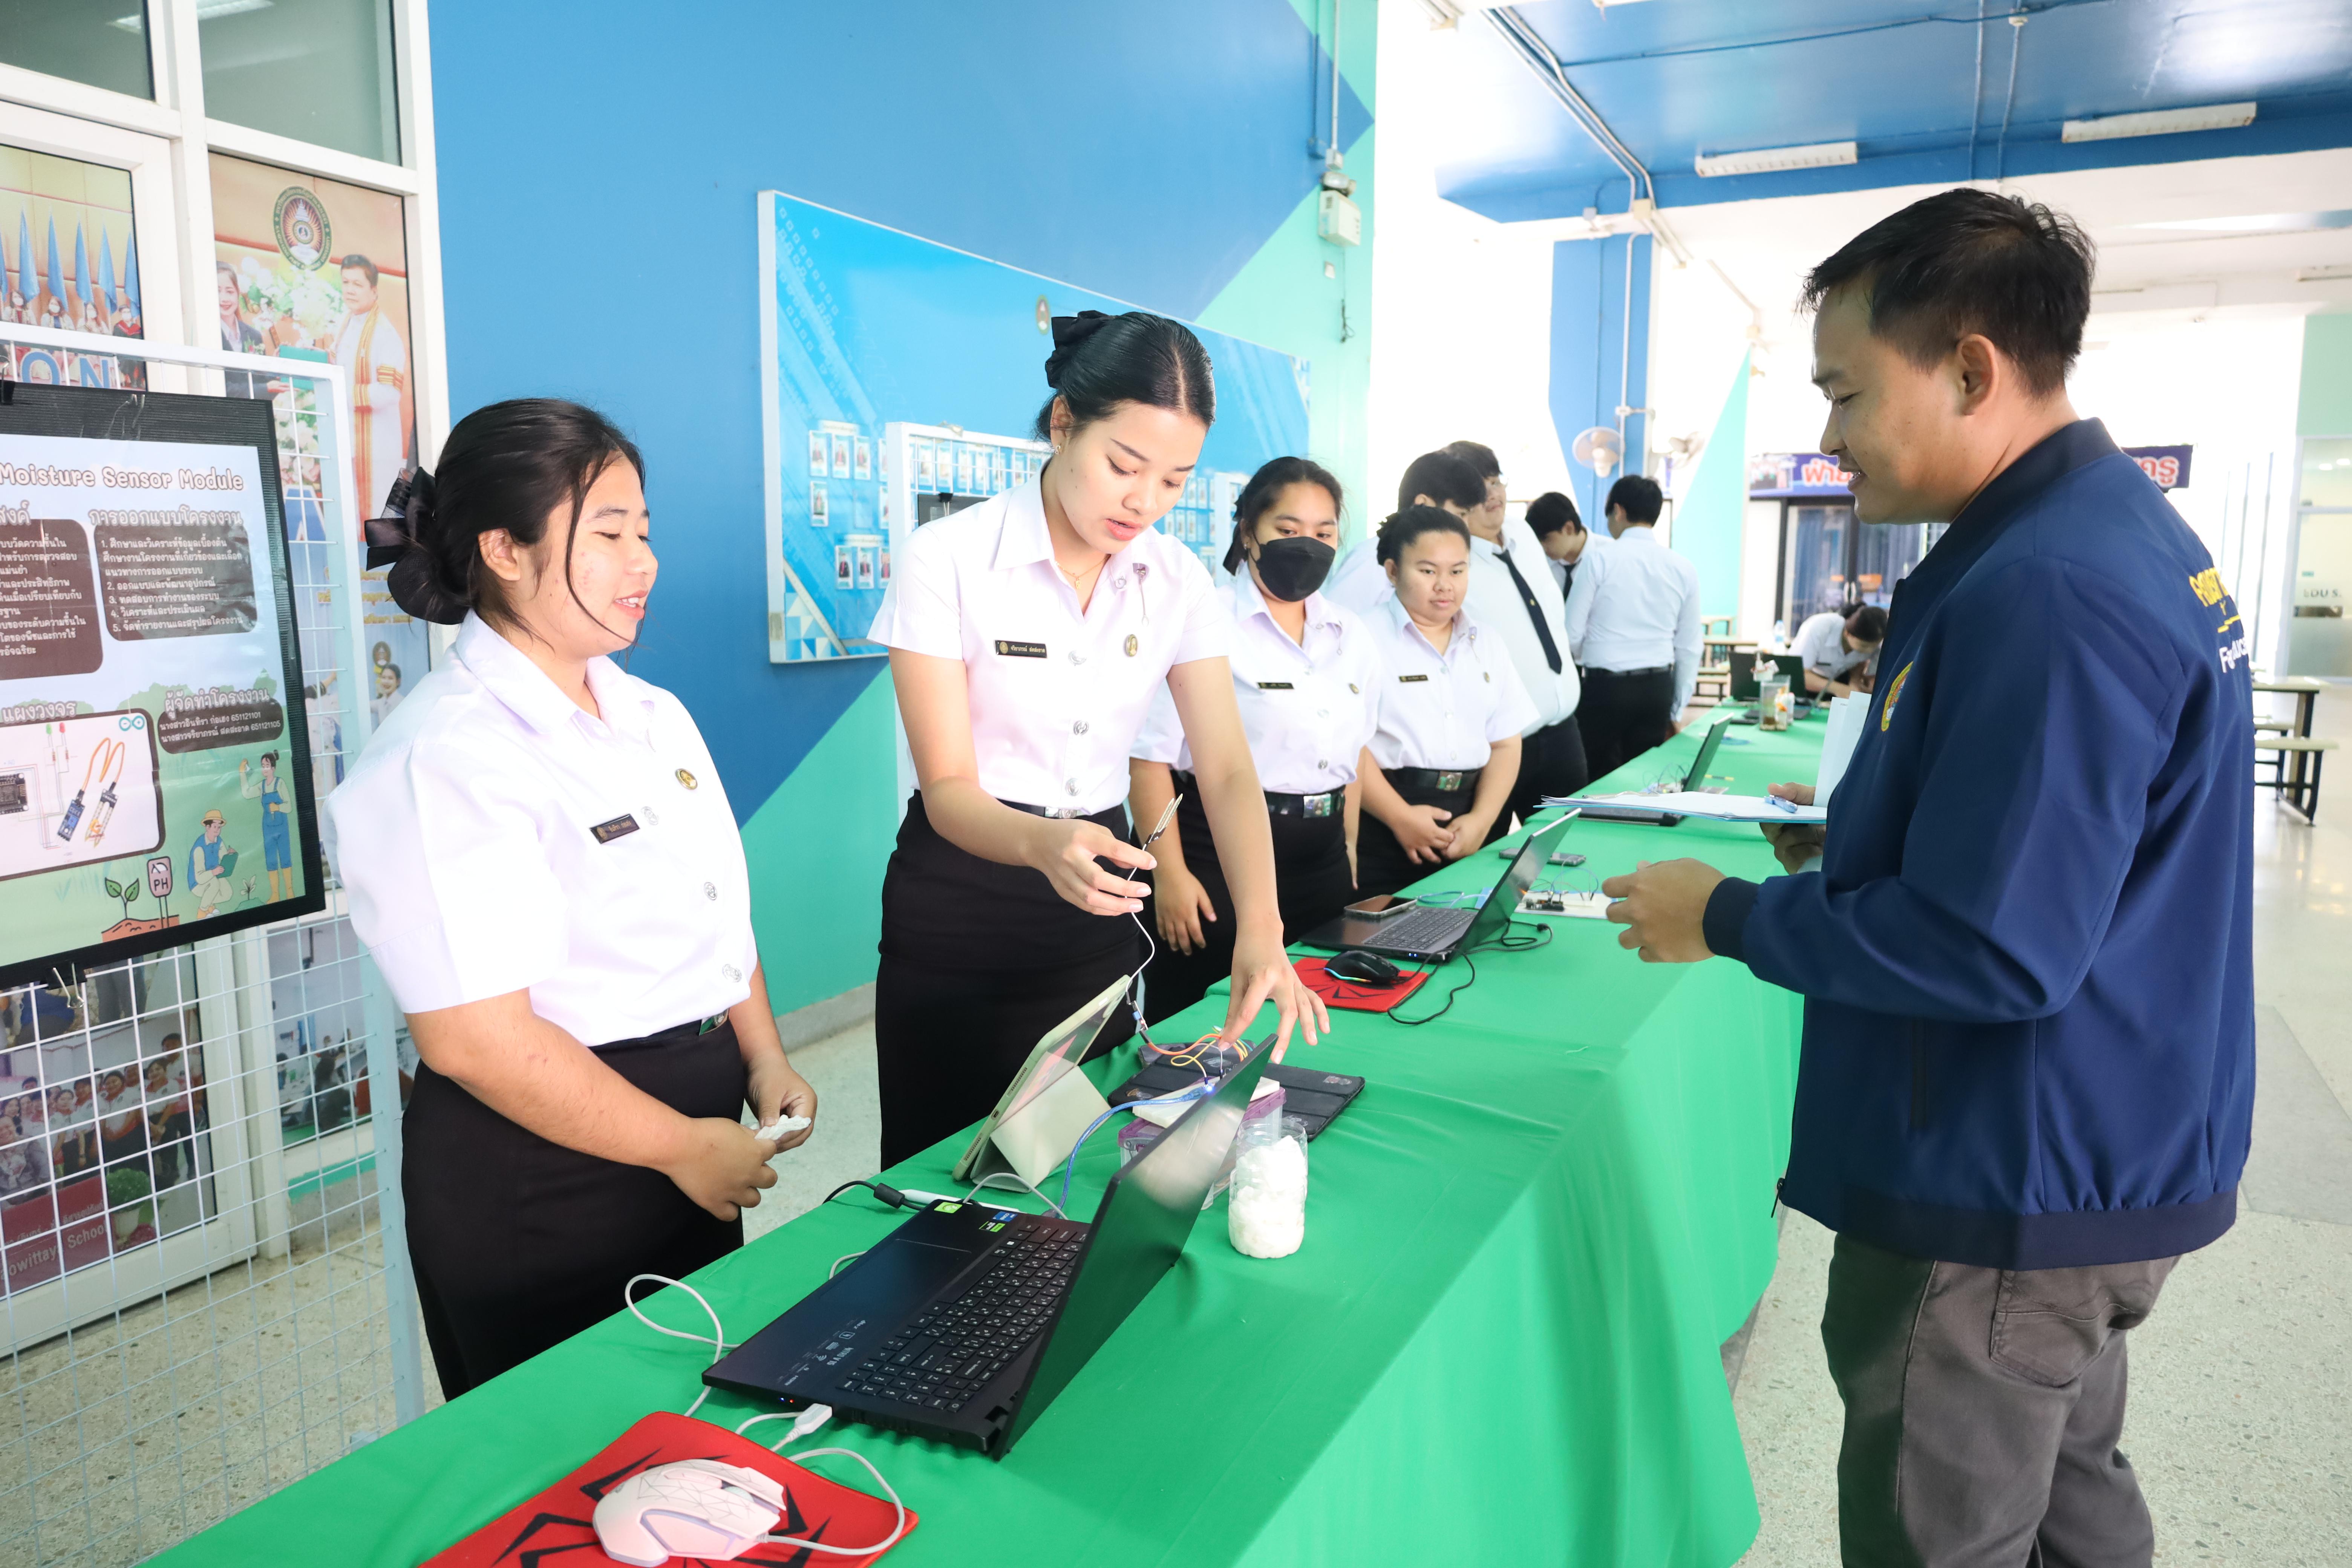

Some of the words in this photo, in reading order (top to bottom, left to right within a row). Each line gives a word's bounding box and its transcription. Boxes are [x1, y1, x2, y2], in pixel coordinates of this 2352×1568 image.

[0, 463, 95, 487] Moisture
[102, 466, 172, 488] Sensor
[179, 466, 243, 490] Module
[89, 504, 243, 525] การออกแบบโครงงาน
[0, 612, 86, 629] บของระดับความชื้นใน
[2, 702, 76, 722] แผงวงจร
[165, 688, 270, 718] ผู้จัดทำโครงงาน
[231, 712, 261, 721] 651121101
[251, 720, 281, 730] 651121105
[154, 879, 168, 891] PH
